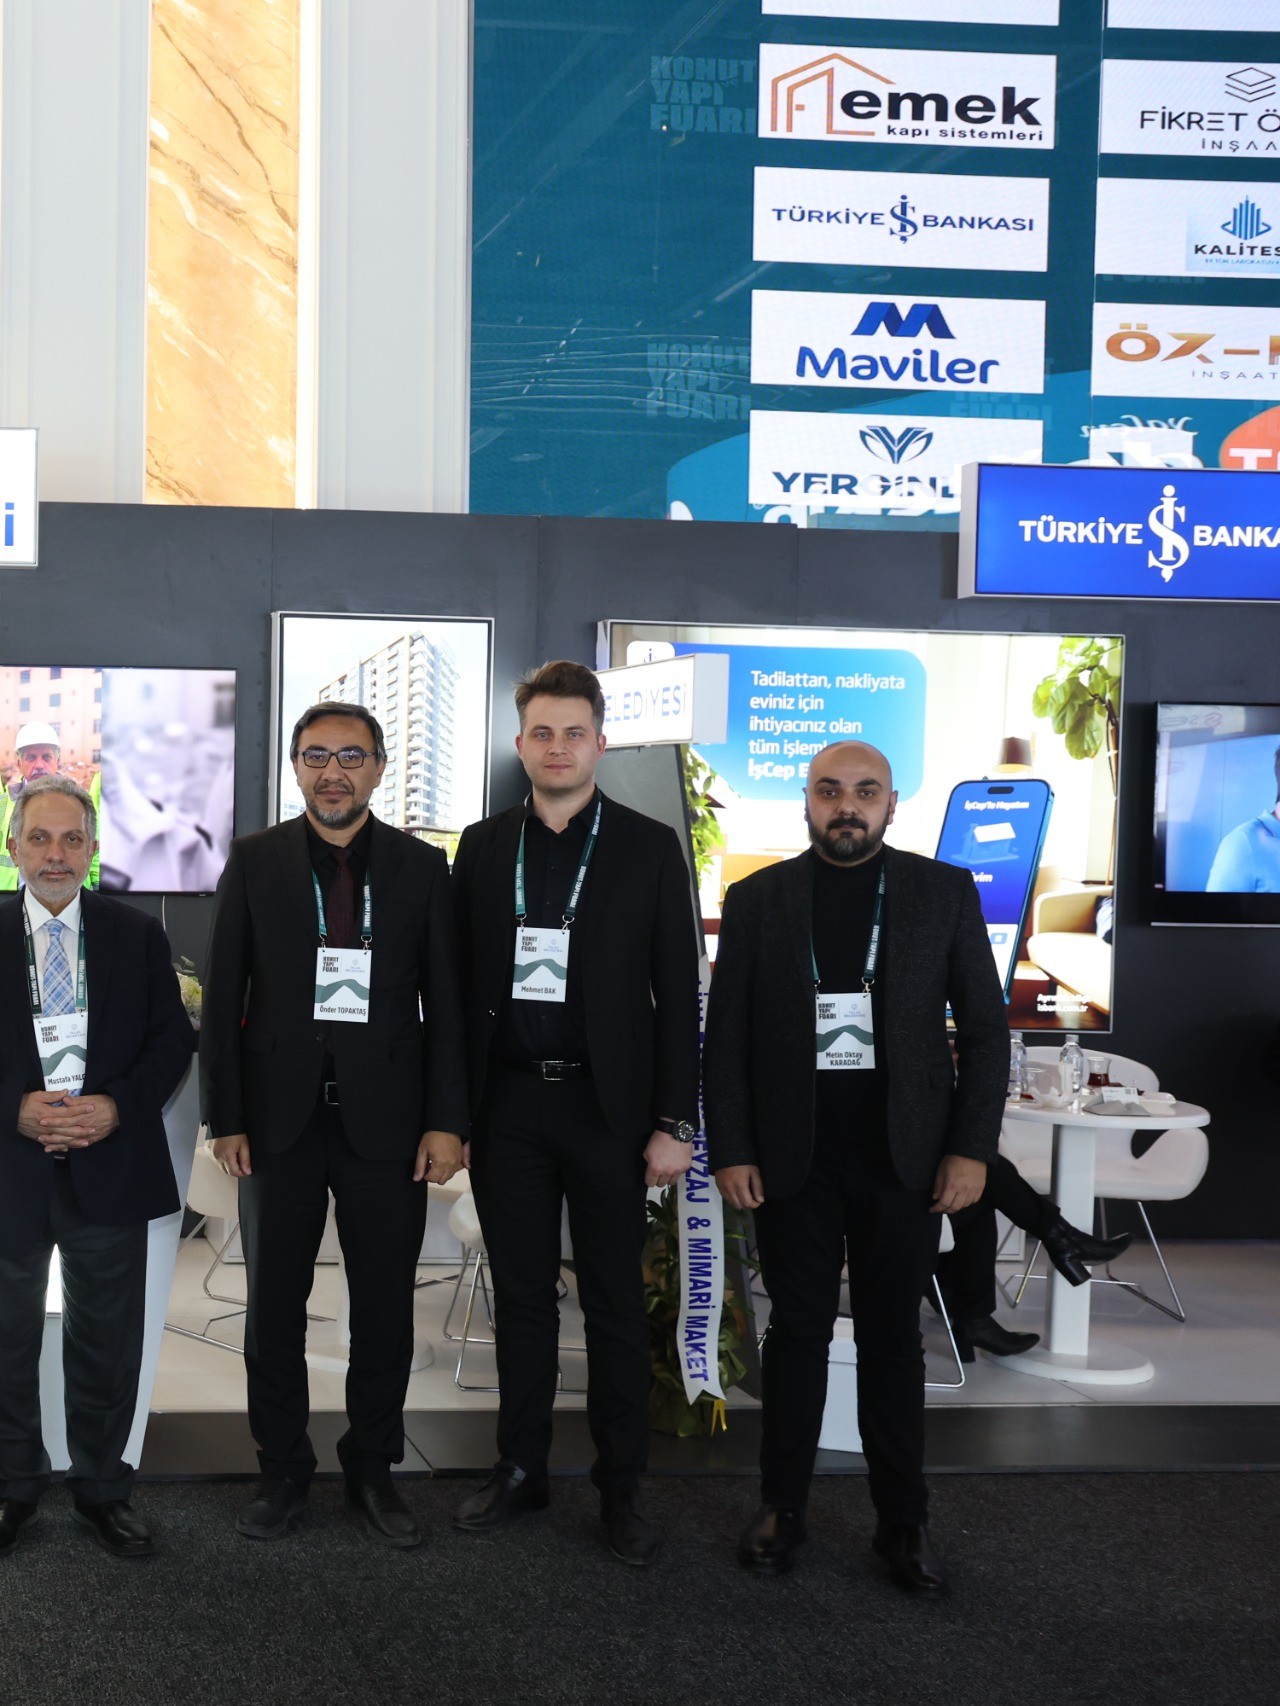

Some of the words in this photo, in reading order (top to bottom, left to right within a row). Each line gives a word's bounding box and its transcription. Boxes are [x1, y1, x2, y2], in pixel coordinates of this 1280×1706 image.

[840, 86, 1041, 127] emek
[1140, 106, 1248, 131] FİKRET
[887, 125, 929, 139] kapı
[938, 127, 1043, 142] sistemleri
[772, 206, 885, 226] TÜRKİYE
[923, 215, 1034, 231] BANKASI
[796, 346, 1000, 385] Maviler
[1019, 514, 1143, 545] TÜRKİYE
[751, 671, 831, 689] Tadilattan,
[835, 673, 905, 692] nakliyata
[749, 694, 794, 709] eviniz
[798, 695, 824, 713] için
[749, 716, 826, 735] ihtiyacınız
[829, 718, 862, 734] olan
[748, 739, 780, 754] tüm
[748, 758, 795, 781] İşCep
[521, 986, 544, 994] Mehmet
[319, 1005, 337, 1013] Önder
[337, 1007, 366, 1016] TOPAKTAŞ
[844, 1051, 862, 1059] Oktay
[48, 1075, 70, 1085] Mustafa
[687, 1237, 718, 1312] MİMARİ
[684, 1314, 709, 1382] MAKET
